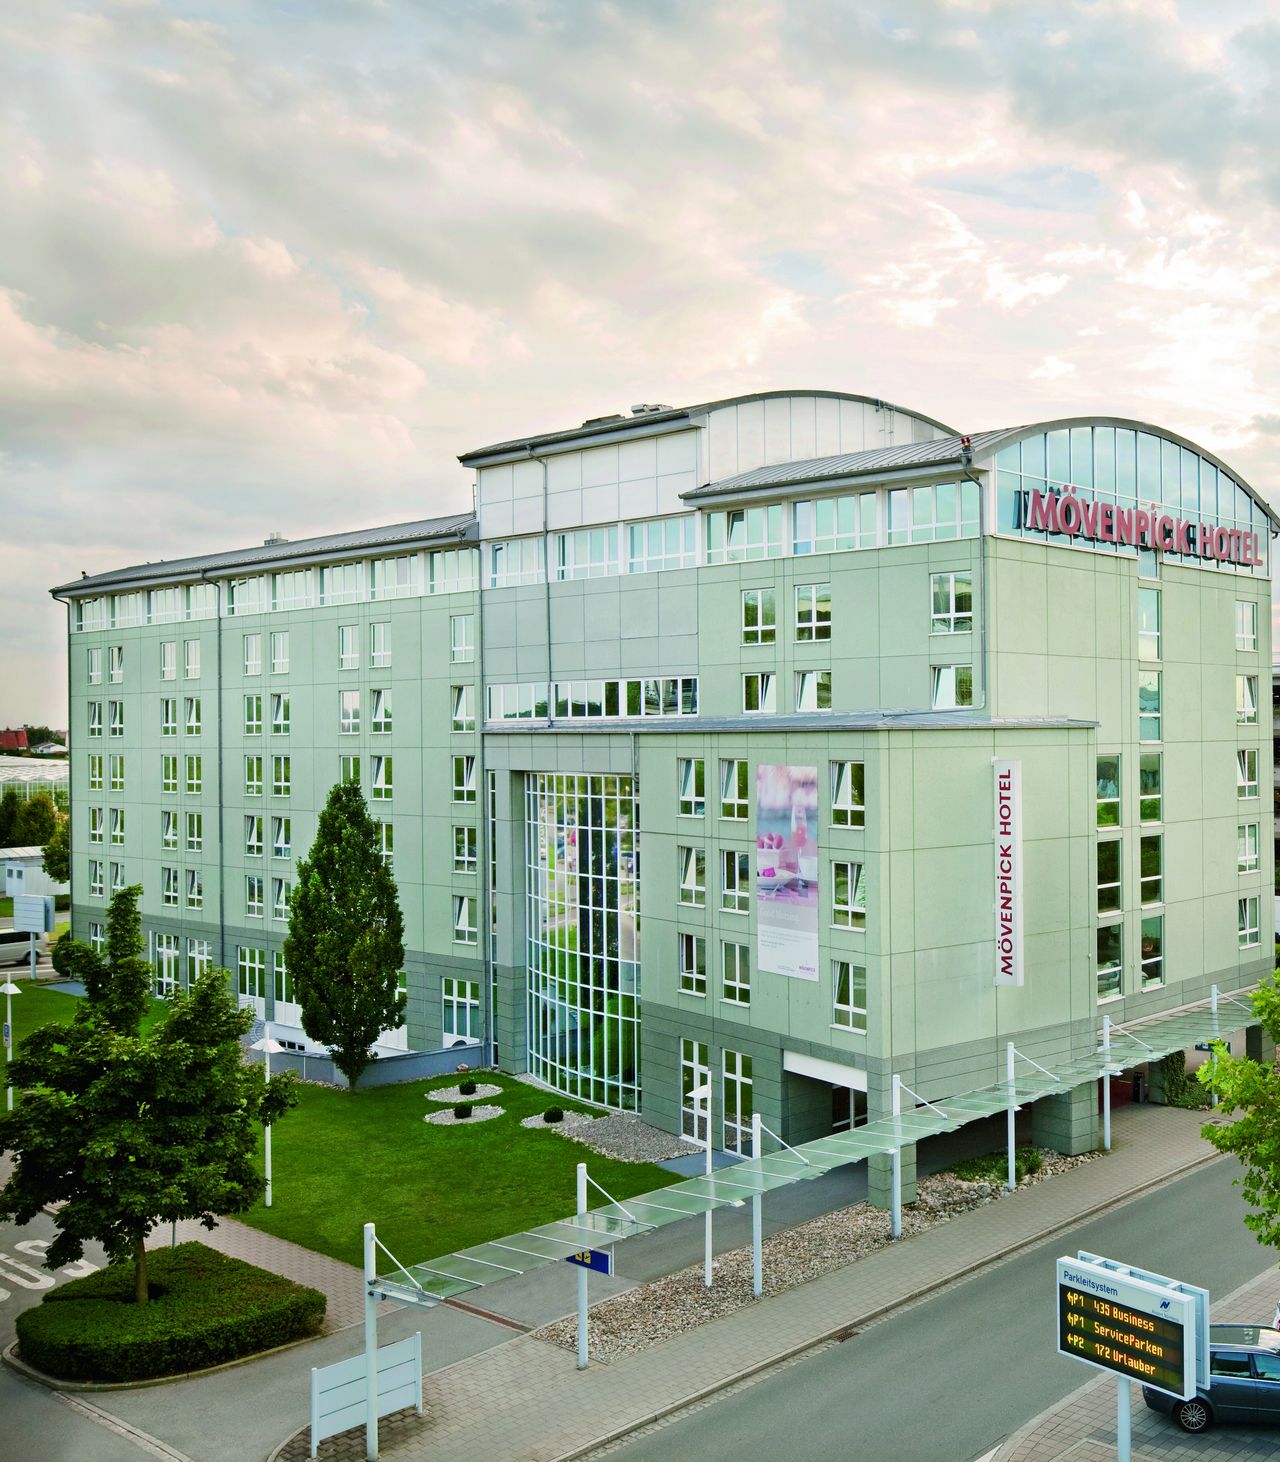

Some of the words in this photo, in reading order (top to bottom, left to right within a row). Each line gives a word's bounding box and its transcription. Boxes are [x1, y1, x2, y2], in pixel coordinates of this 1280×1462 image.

[1029, 485, 1191, 554] MÖVENPICK
[1199, 522, 1263, 566] HOTEL
[999, 769, 1011, 835] HOTEL
[997, 845, 1013, 976] MÖVENPICK
[1063, 1270, 1119, 1297] Parkleitsystem
[1073, 1293, 1084, 1308] P1
[1094, 1300, 1110, 1316] 435
[1112, 1304, 1155, 1332] Business
[1073, 1313, 1085, 1329] P1
[1094, 1321, 1163, 1358] ServiceParken
[1073, 1335, 1085, 1350] P2
[1095, 1343, 1111, 1359] 172
[1112, 1349, 1156, 1376] Urlauber
